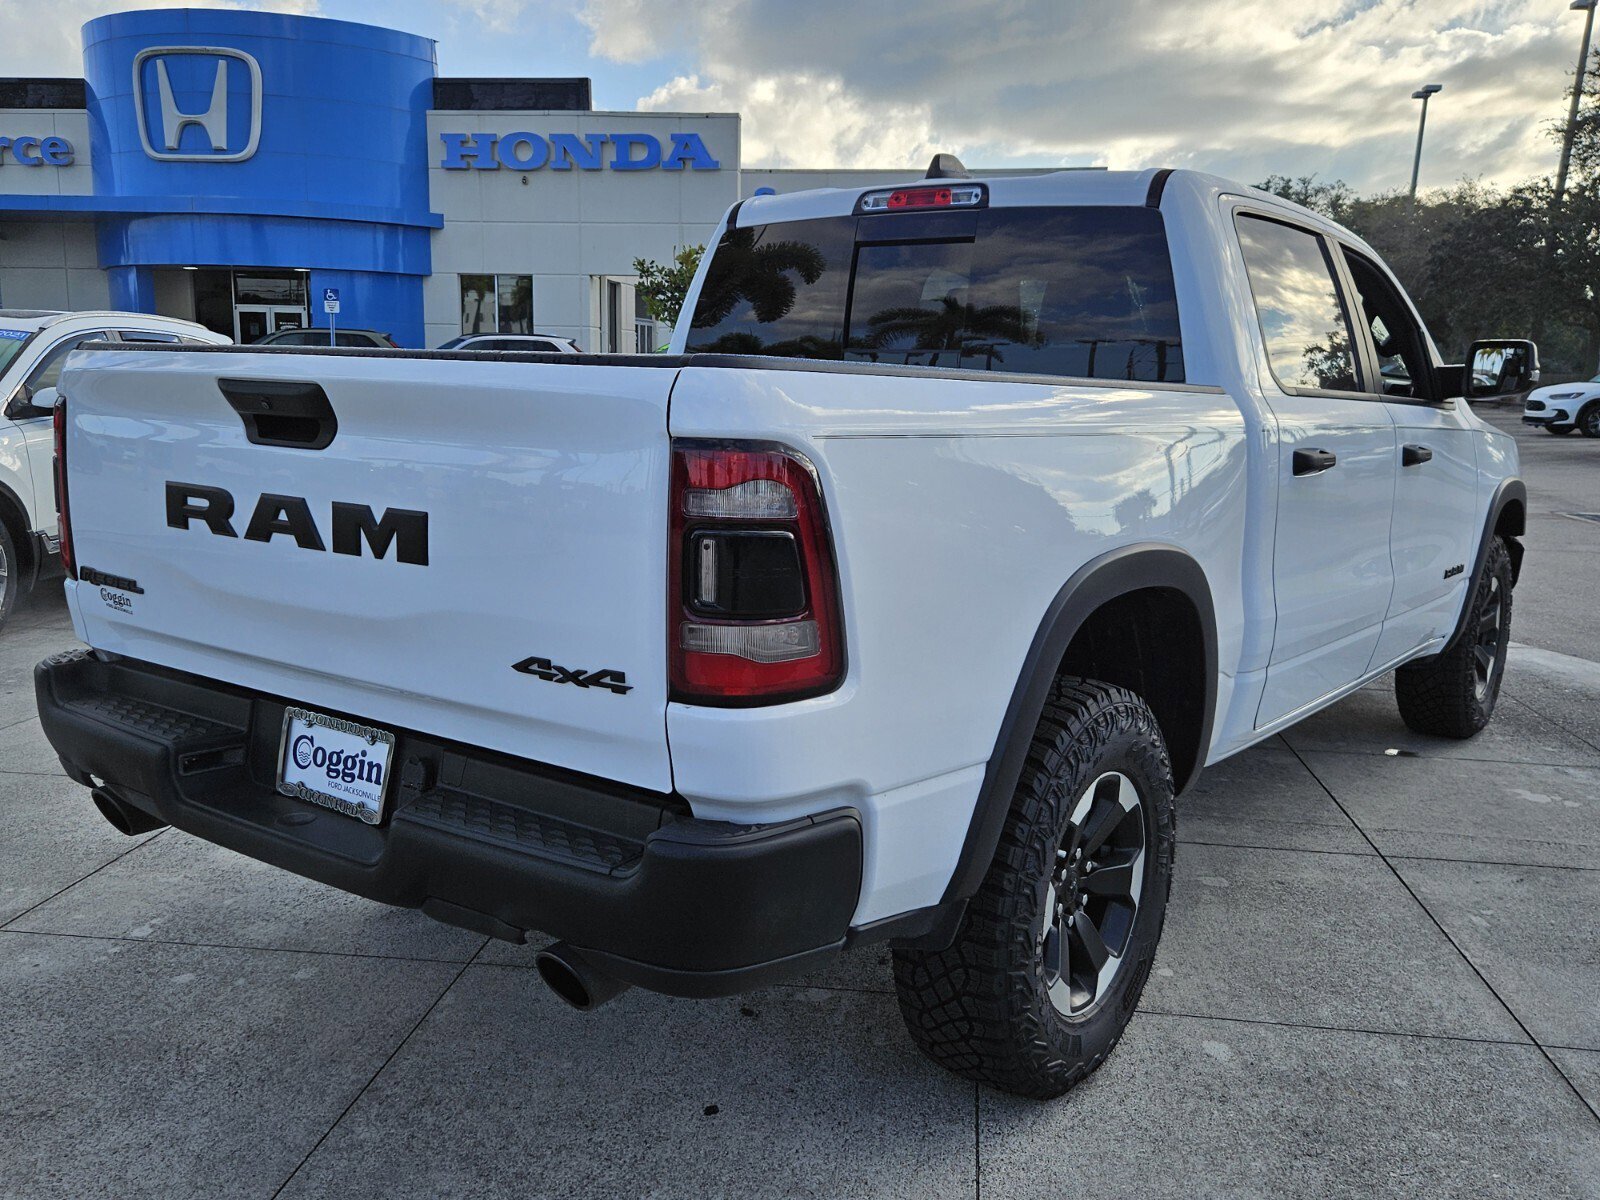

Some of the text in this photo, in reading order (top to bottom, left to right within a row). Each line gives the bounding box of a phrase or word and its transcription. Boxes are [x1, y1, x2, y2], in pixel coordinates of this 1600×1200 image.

[439, 131, 721, 171] HONDA
[164, 480, 430, 567] RAM
[100, 587, 132, 608] Coggin
[292, 734, 383, 786] Coggin
[299, 787, 333, 808] COGGIN
[334, 799, 358, 816] FORD
[327, 780, 343, 791] FORD
